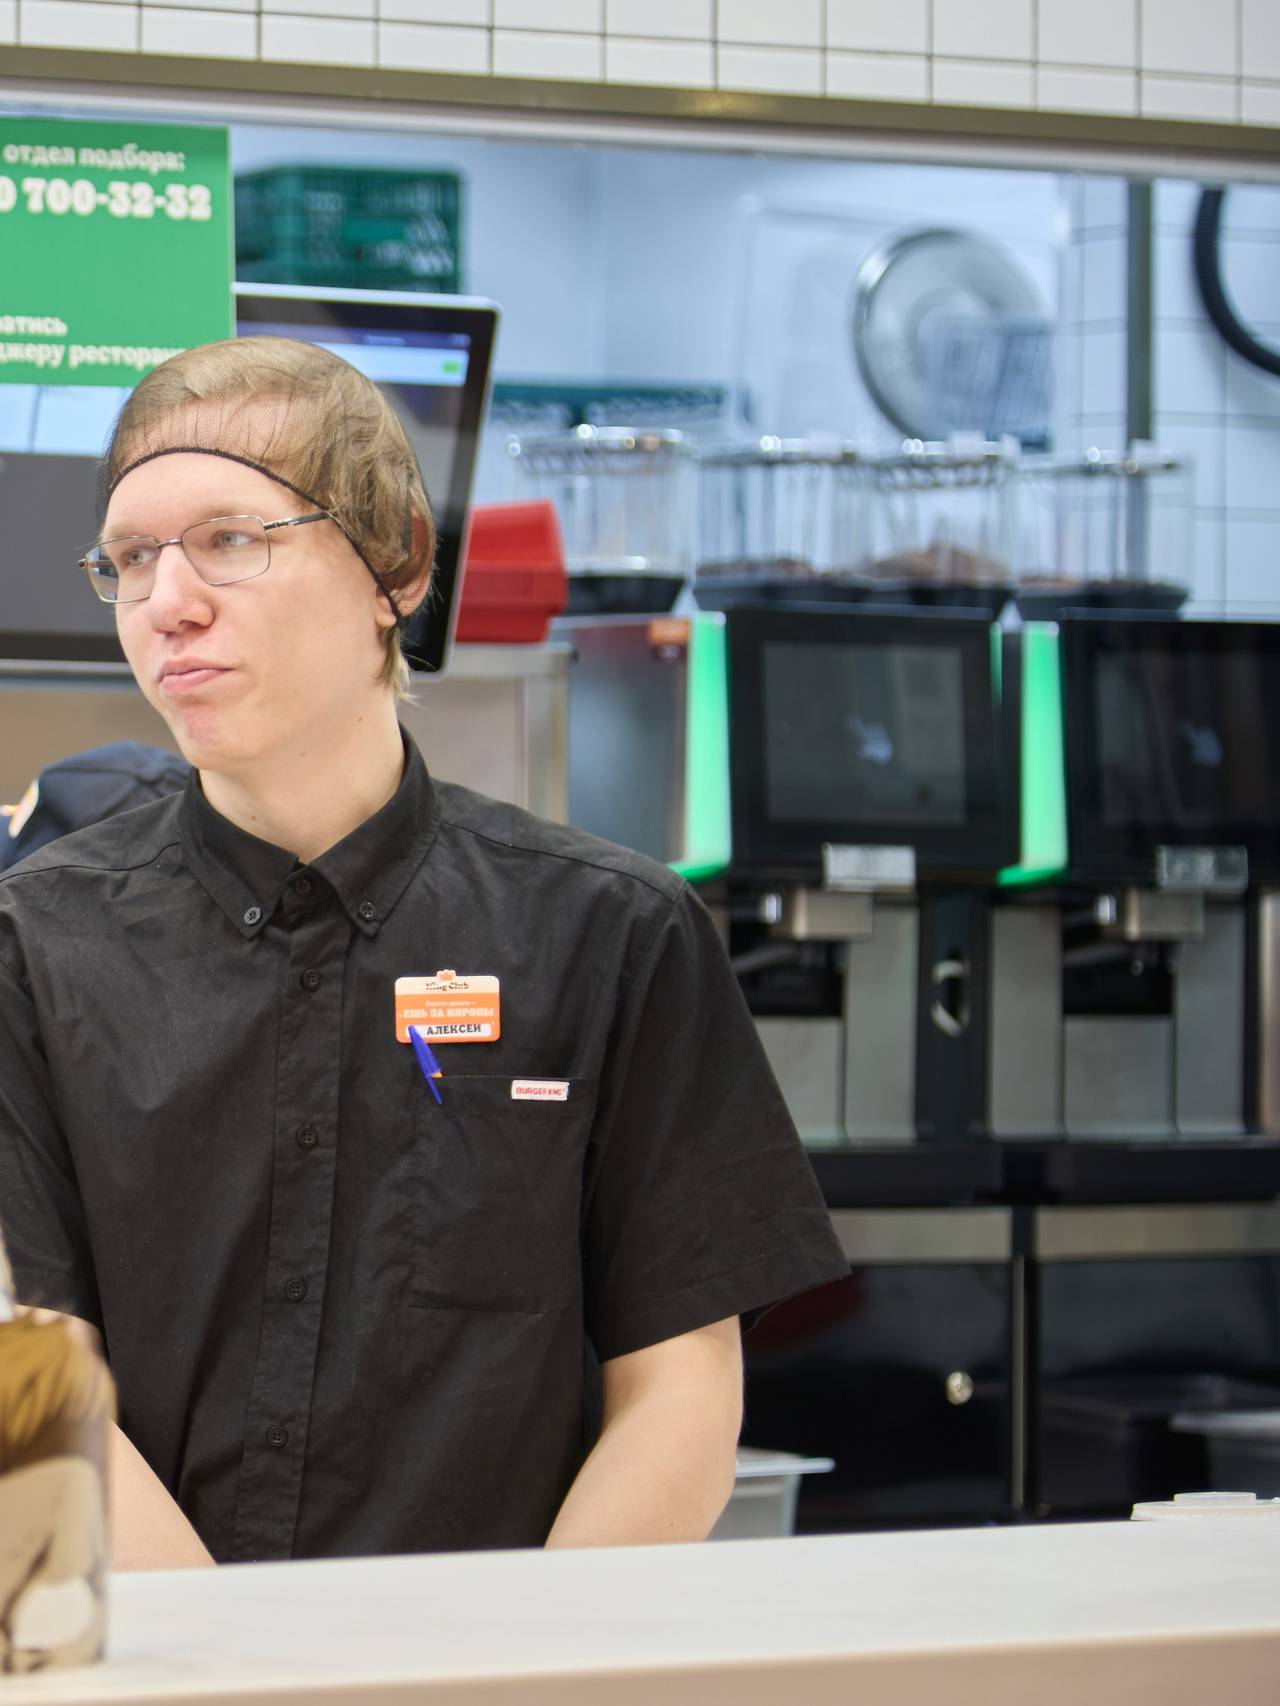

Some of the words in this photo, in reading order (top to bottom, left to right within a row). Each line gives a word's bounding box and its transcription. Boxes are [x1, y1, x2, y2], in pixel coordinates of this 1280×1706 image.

[3, 144, 75, 168] отдел
[78, 142, 185, 176] подбора:
[21, 176, 212, 221] 700-32-32
[68, 344, 188, 370] ресторан
[430, 1008, 445, 1018] ЗА
[516, 1087, 547, 1096] BURGER
